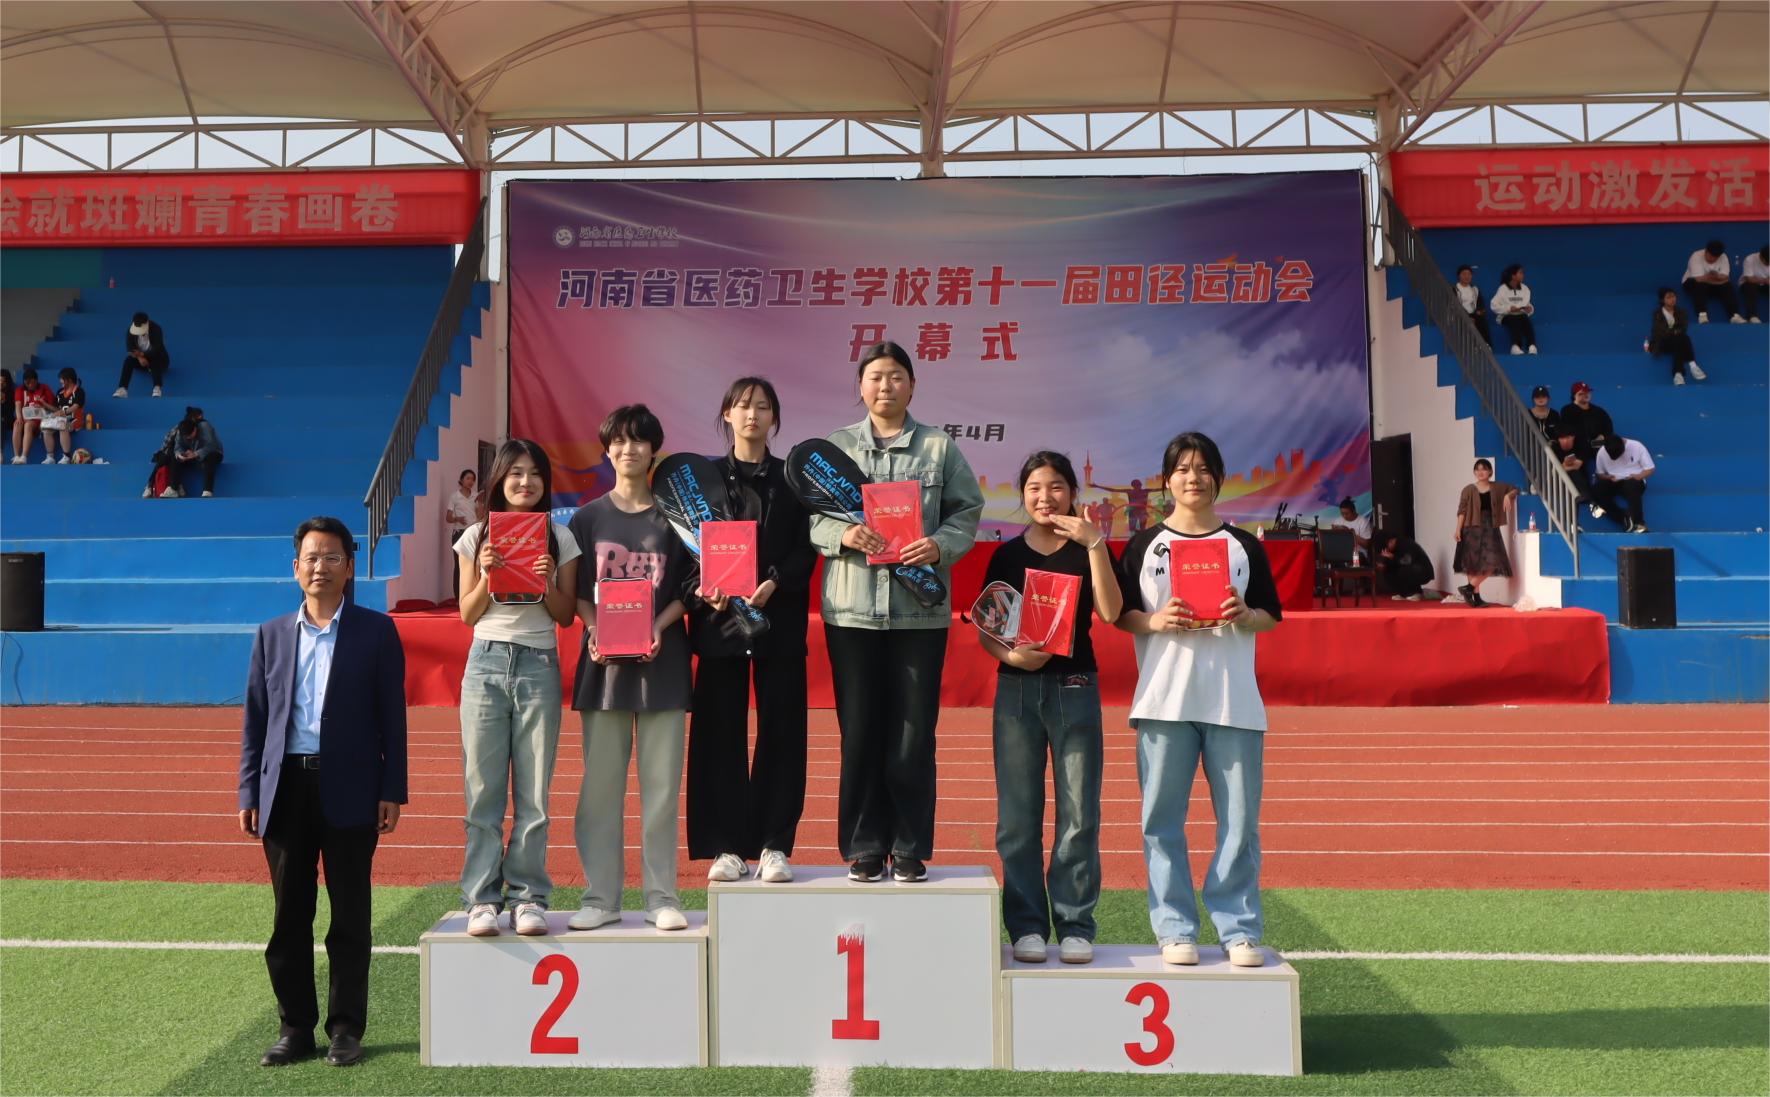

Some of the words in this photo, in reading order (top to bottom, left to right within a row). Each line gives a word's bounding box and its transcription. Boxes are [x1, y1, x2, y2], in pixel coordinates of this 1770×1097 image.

[1474, 157, 1756, 211] 运动激发活
[557, 261, 1314, 308] 河南省医药卫生学校第十一届田径运动会
[930, 423, 1005, 442] 年4月
[1182, 562, 1220, 571] 荣誉证书
[605, 601, 643, 609] 荣誉证书
[530, 954, 579, 1054] 2
[831, 923, 880, 1040] 1
[1124, 982, 1175, 1067] 3
